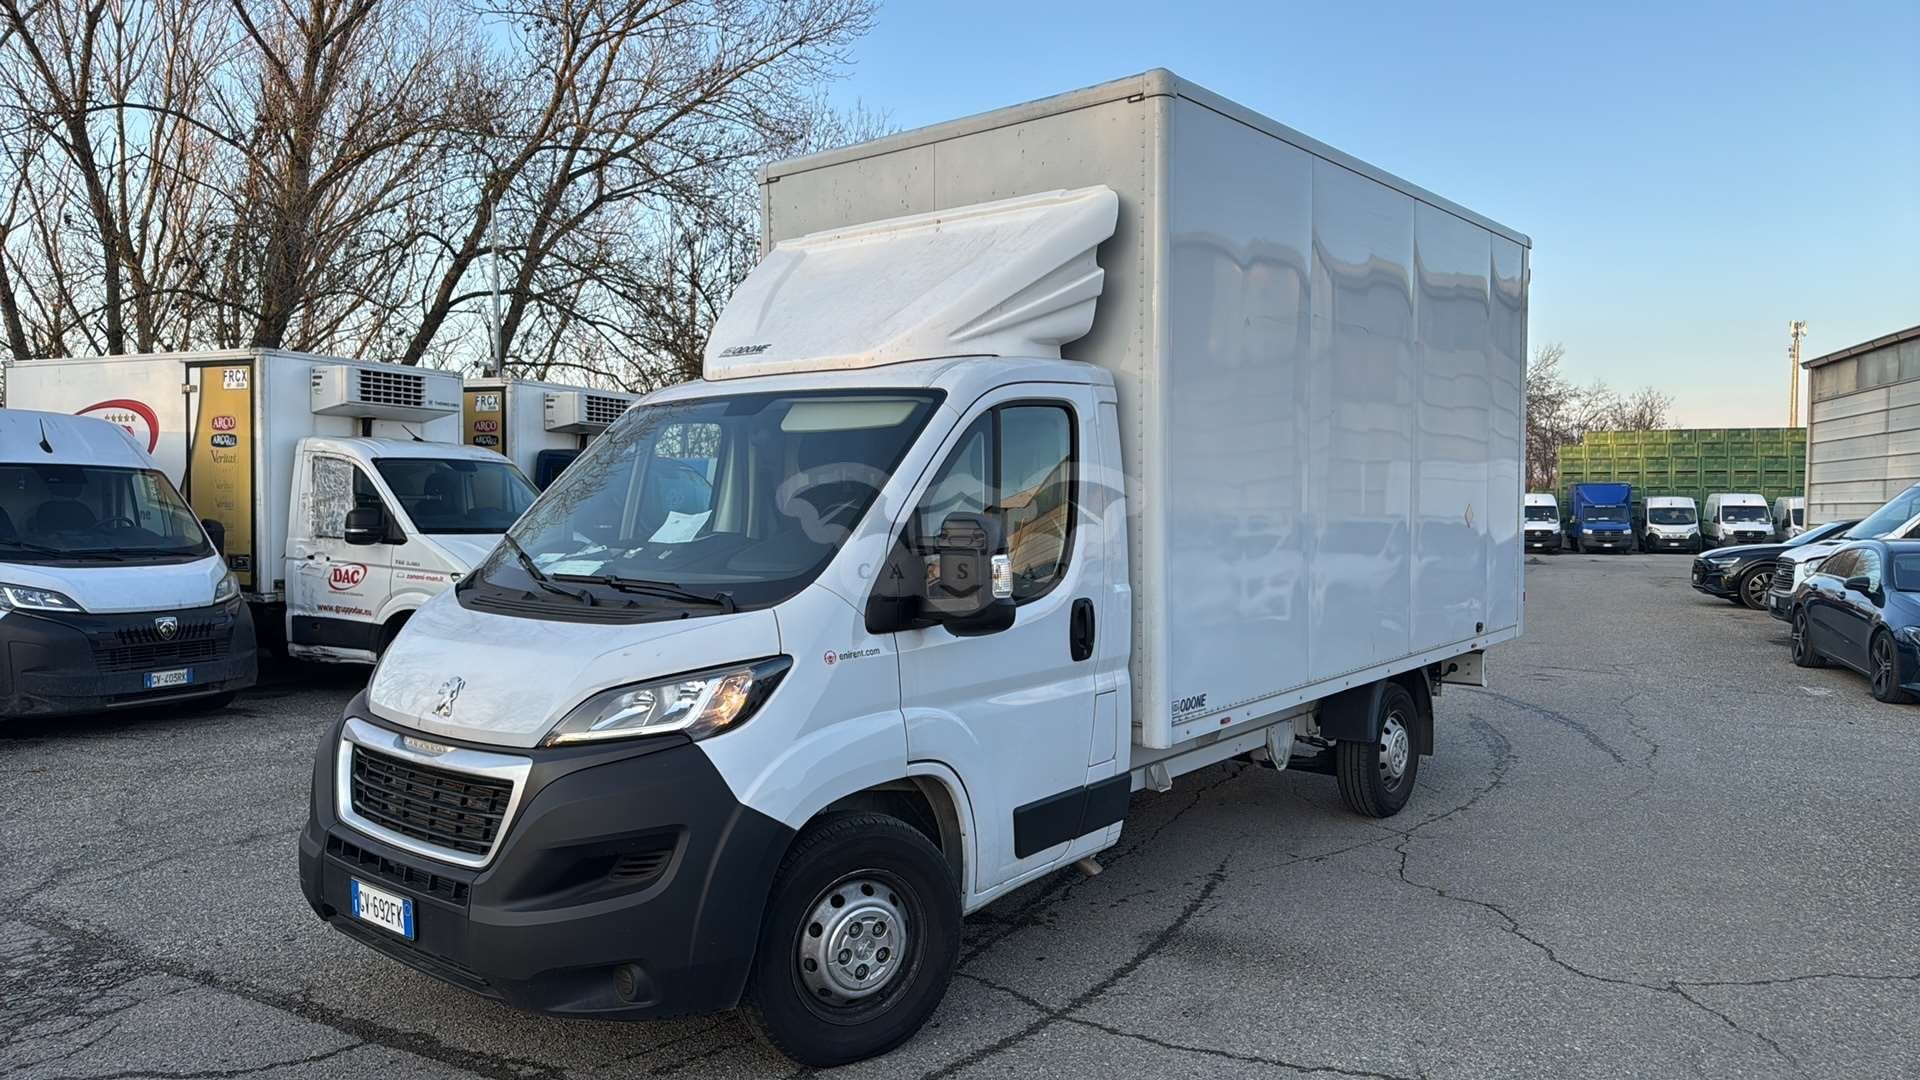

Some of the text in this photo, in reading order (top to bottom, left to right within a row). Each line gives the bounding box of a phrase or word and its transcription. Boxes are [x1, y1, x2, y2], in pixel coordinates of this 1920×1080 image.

[212, 417, 235, 429] ARCO
[475, 422, 497, 432] ARCO
[333, 568, 360, 584] DAC
[839, 648, 880, 660] enirent.com
[1180, 693, 1206, 712] ODONE
